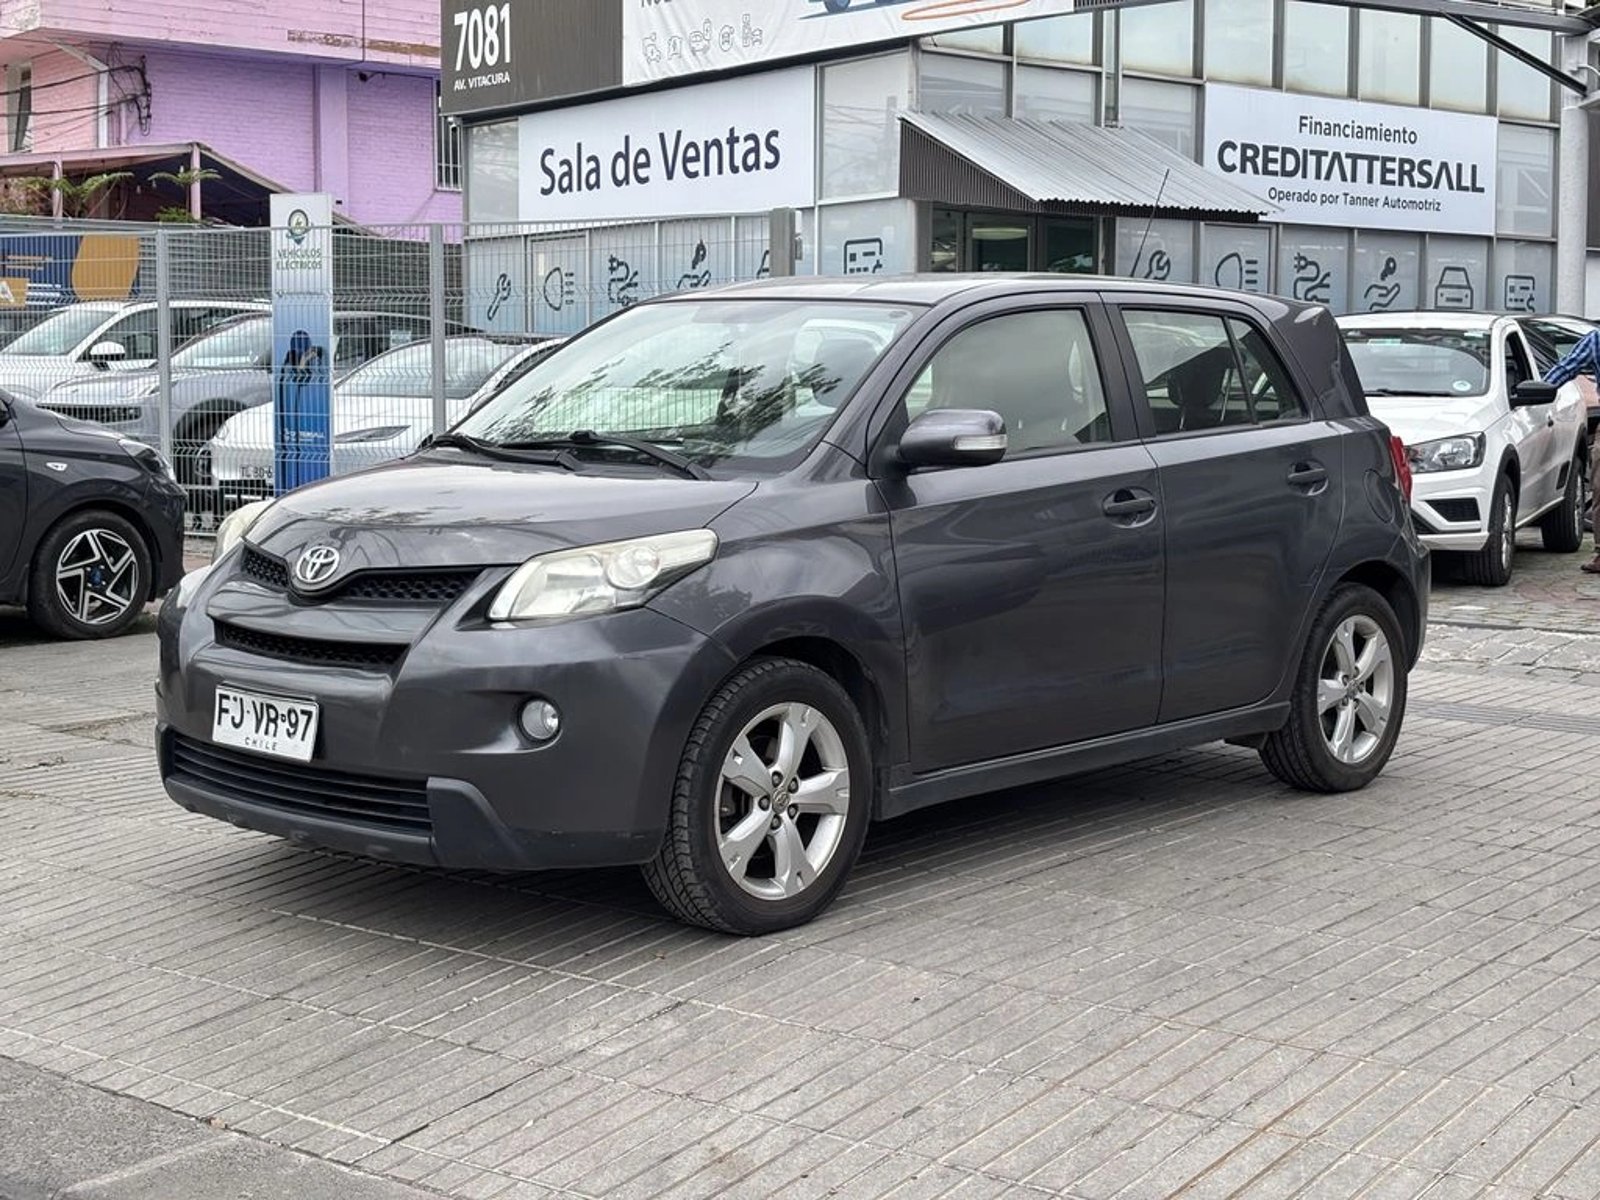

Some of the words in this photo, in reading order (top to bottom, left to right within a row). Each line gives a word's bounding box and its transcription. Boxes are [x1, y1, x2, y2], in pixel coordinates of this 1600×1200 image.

[454, 3, 511, 71] 7081
[454, 79, 466, 91] AV.
[468, 71, 510, 89] VITACURA
[1298, 115, 1418, 145] Financiamiento
[540, 142, 601, 196] Sala
[611, 135, 650, 187] de
[659, 126, 780, 181] Ventas
[1217, 140, 1485, 193] CREDITATTERSALL
[1268, 187, 1318, 205] Operado
[1320, 193, 1339, 206] por
[1343, 193, 1379, 208] Tanner
[1382, 197, 1441, 212] Automotriz
[245, 736, 277, 751] CHILE
